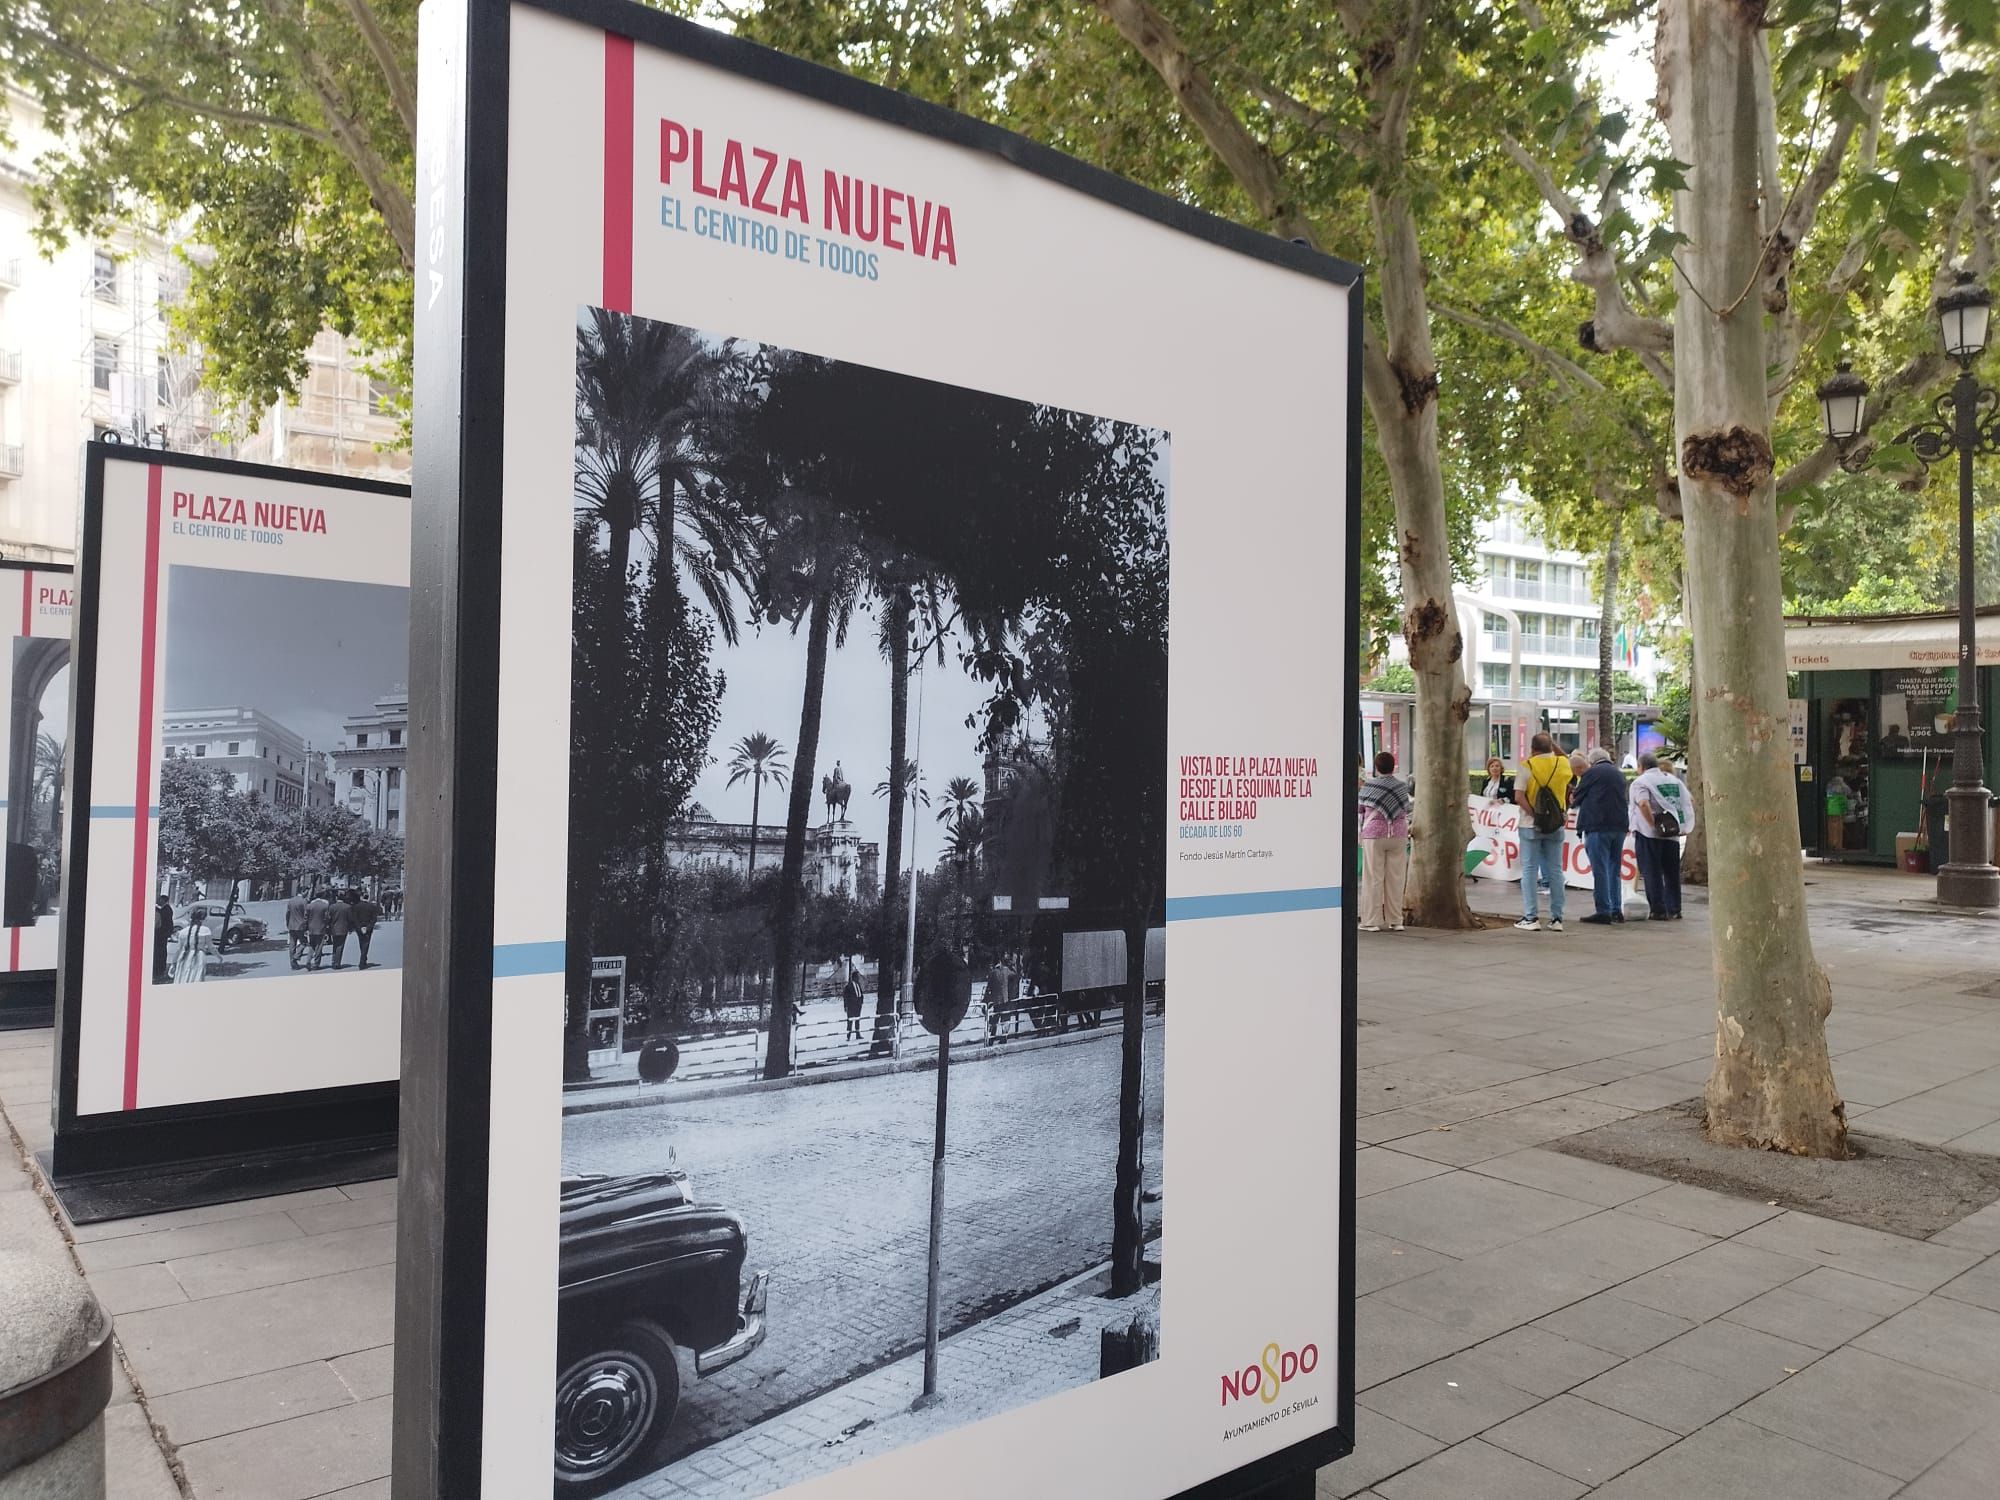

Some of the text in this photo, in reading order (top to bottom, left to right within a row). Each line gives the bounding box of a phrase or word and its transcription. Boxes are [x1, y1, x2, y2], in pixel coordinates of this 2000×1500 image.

[660, 118, 957, 266] PLAZA NUEVA
[661, 196, 879, 281] EL CENTRO DE TODOS
[173, 491, 327, 534] PLAZA NUEVA
[173, 521, 284, 545] EL CENTRO DE TODOS
[1792, 655, 1829, 665] Tickets
[1180, 756, 1318, 777] VISTA DE LA PLAZA NUEVA
[1180, 778, 1312, 799] DESDE LA ESQUINA DE LA
[1180, 800, 1257, 821] CALLE BILBAO
[1179, 824, 1243, 839] DÉCADA DE LOS 60
[1179, 852, 1203, 861] Fondo
[1204, 851, 1224, 860] Jesús
[1224, 849, 1246, 860] Martín
